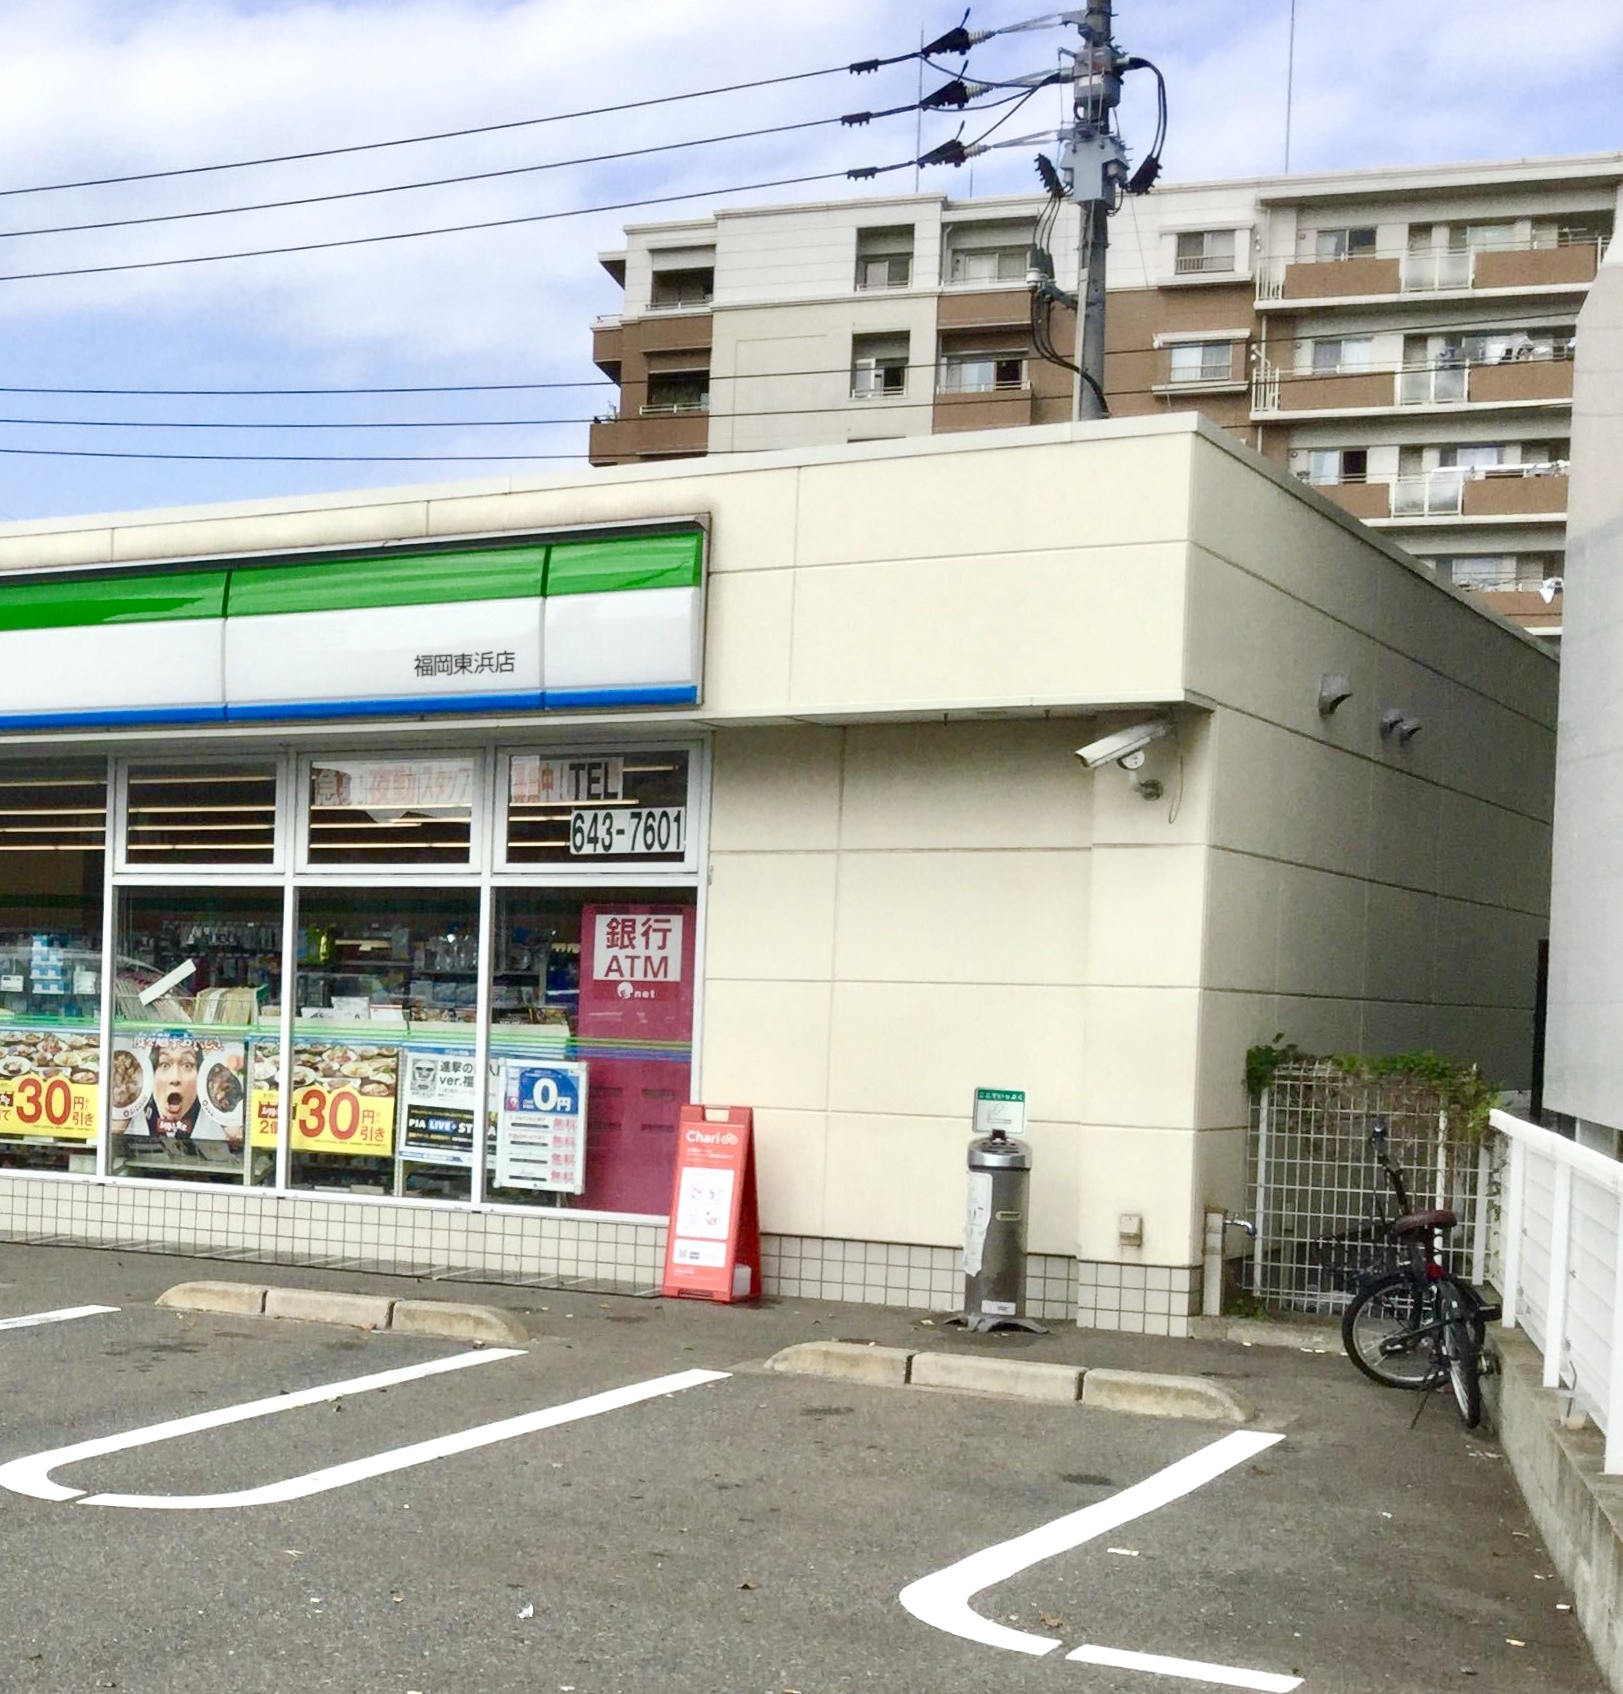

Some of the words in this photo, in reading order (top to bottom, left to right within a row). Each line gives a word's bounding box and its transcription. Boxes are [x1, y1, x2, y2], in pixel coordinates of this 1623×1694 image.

[414, 651, 515, 677] 福岡東浜店
[569, 760, 618, 801] TEL
[572, 809, 682, 853] 643-7601
[605, 917, 672, 951] 銀行
[604, 955, 669, 979] ATM
[15, 1077, 72, 1125] 30
[298, 1089, 360, 1140] 30
[408, 1119, 427, 1129] PIA
[685, 1130, 721, 1144] Chari
